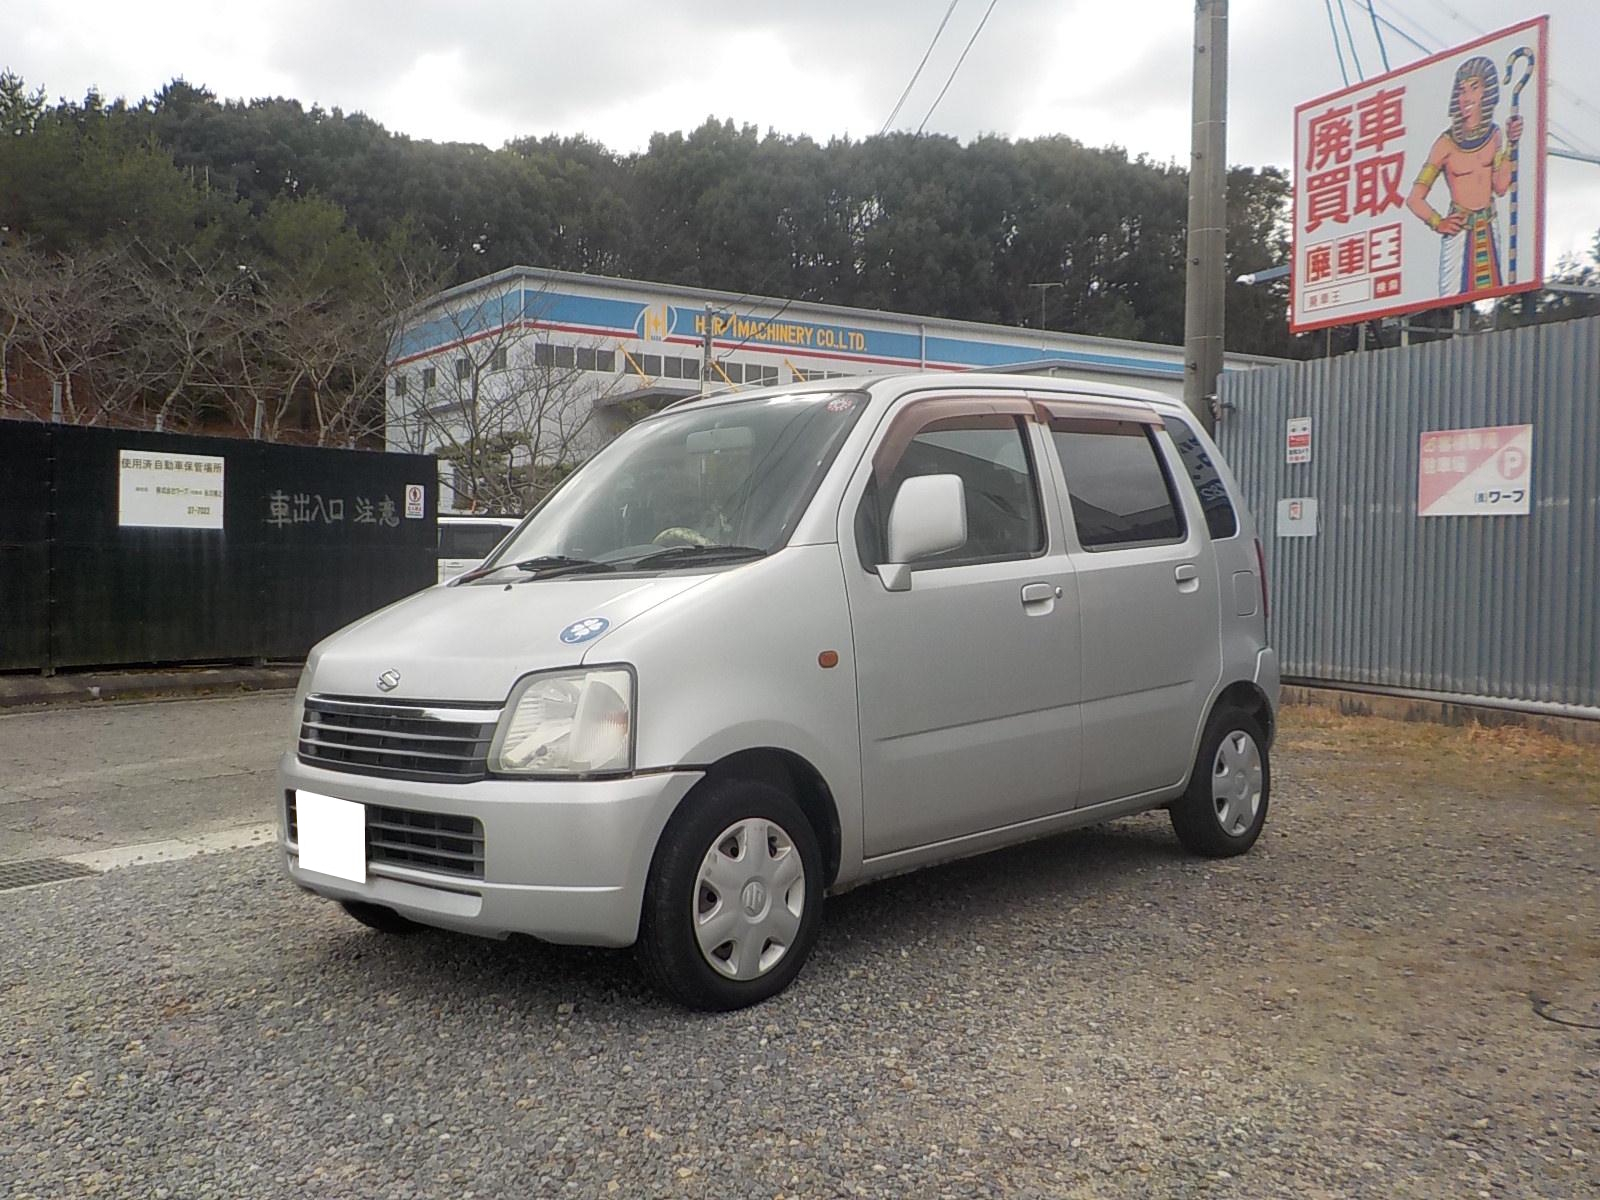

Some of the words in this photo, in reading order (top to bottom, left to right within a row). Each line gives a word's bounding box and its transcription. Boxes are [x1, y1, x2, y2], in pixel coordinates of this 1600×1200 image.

[1305, 86, 1406, 172] 廃車
[1304, 151, 1405, 233] 買取
[695, 312, 737, 337] HRA
[738, 319, 814, 345] MACHINERY
[265, 489, 344, 528] 車出入口
[353, 494, 400, 528] 注意
